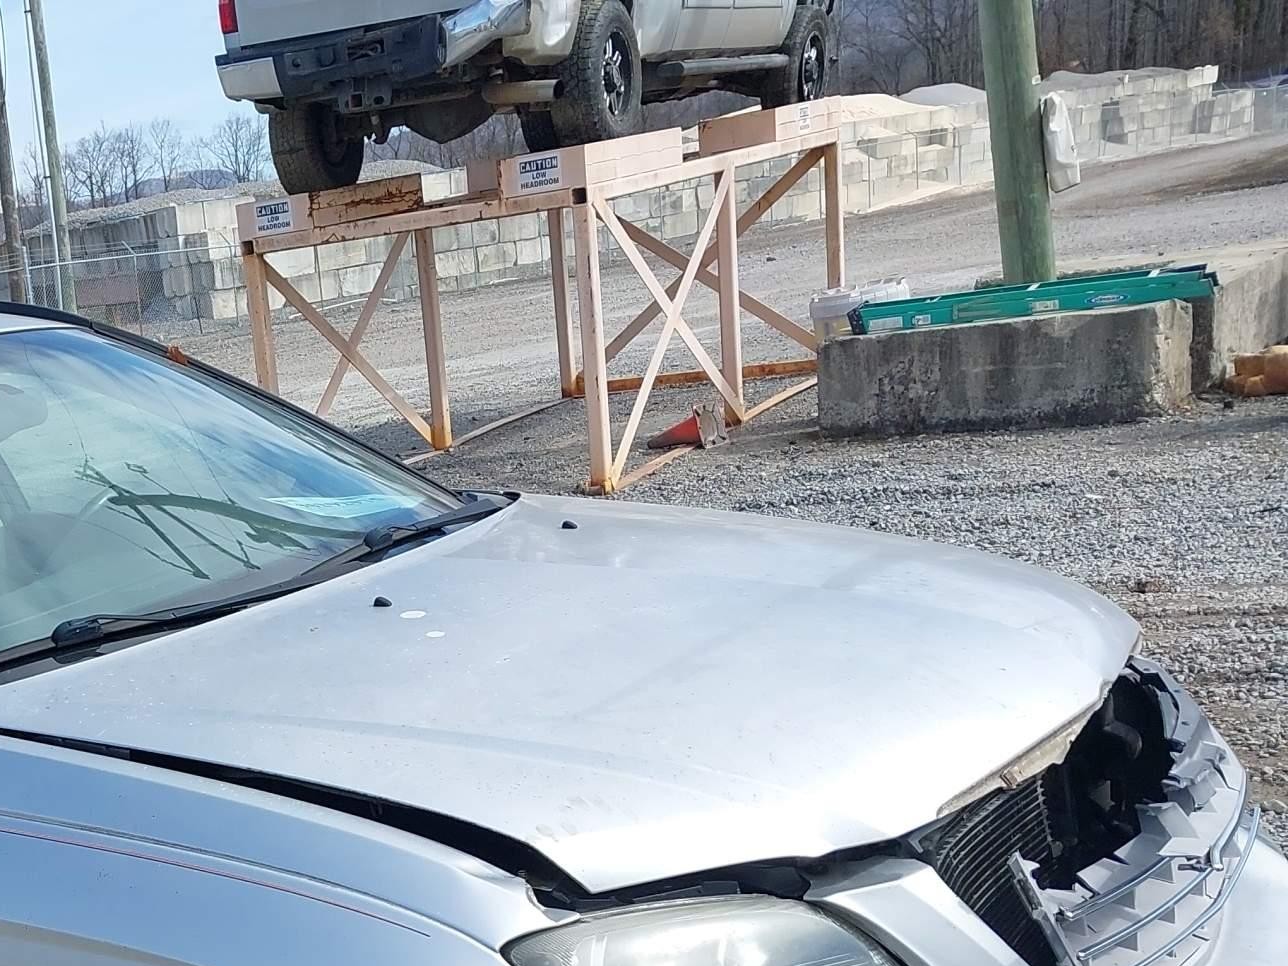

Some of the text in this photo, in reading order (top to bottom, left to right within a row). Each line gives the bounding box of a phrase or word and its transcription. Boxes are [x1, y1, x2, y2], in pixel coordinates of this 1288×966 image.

[520, 158, 557, 172] CAUTION
[532, 170, 547, 180] LOW
[521, 177, 559, 190] HEADROOM
[257, 203, 289, 216] CAUTION
[267, 215, 280, 223] LOW
